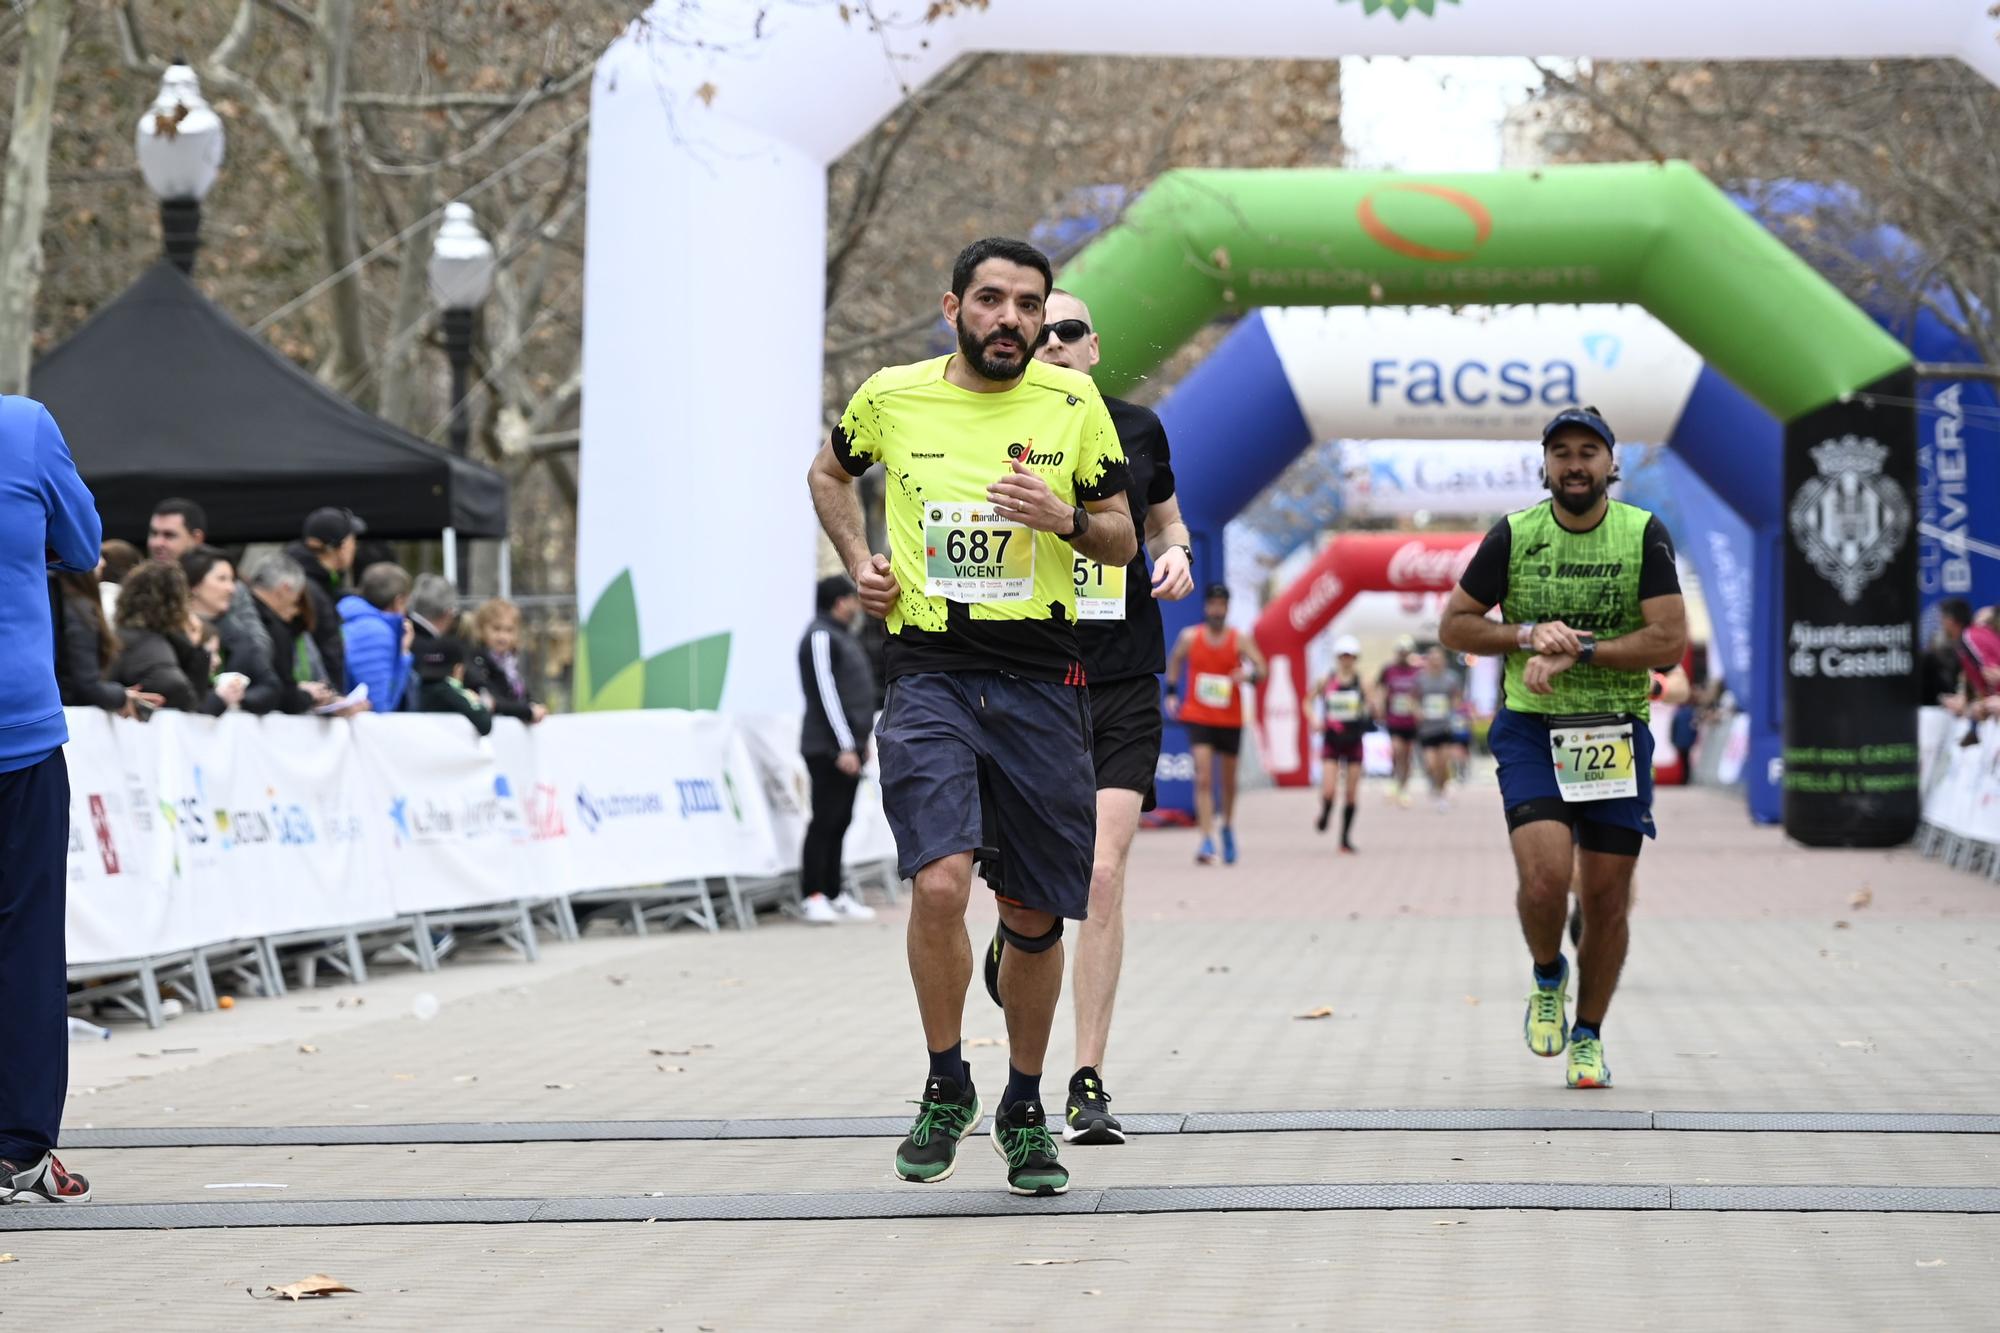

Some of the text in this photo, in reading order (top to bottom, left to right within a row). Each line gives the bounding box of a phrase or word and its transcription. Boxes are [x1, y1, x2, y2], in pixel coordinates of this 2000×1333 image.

[1026, 449, 1064, 467] km0
[1934, 383, 1973, 593] BAVIERA
[946, 529, 1012, 564] 687
[954, 566, 1004, 577] VICENT
[1073, 558, 1103, 586] 51
[1556, 557, 1622, 578] MARATÓ
[1074, 587, 1087, 597] AL
[1790, 650, 1817, 677] de
[1569, 745, 1616, 771] 722
[1584, 772, 1604, 781] EDU
